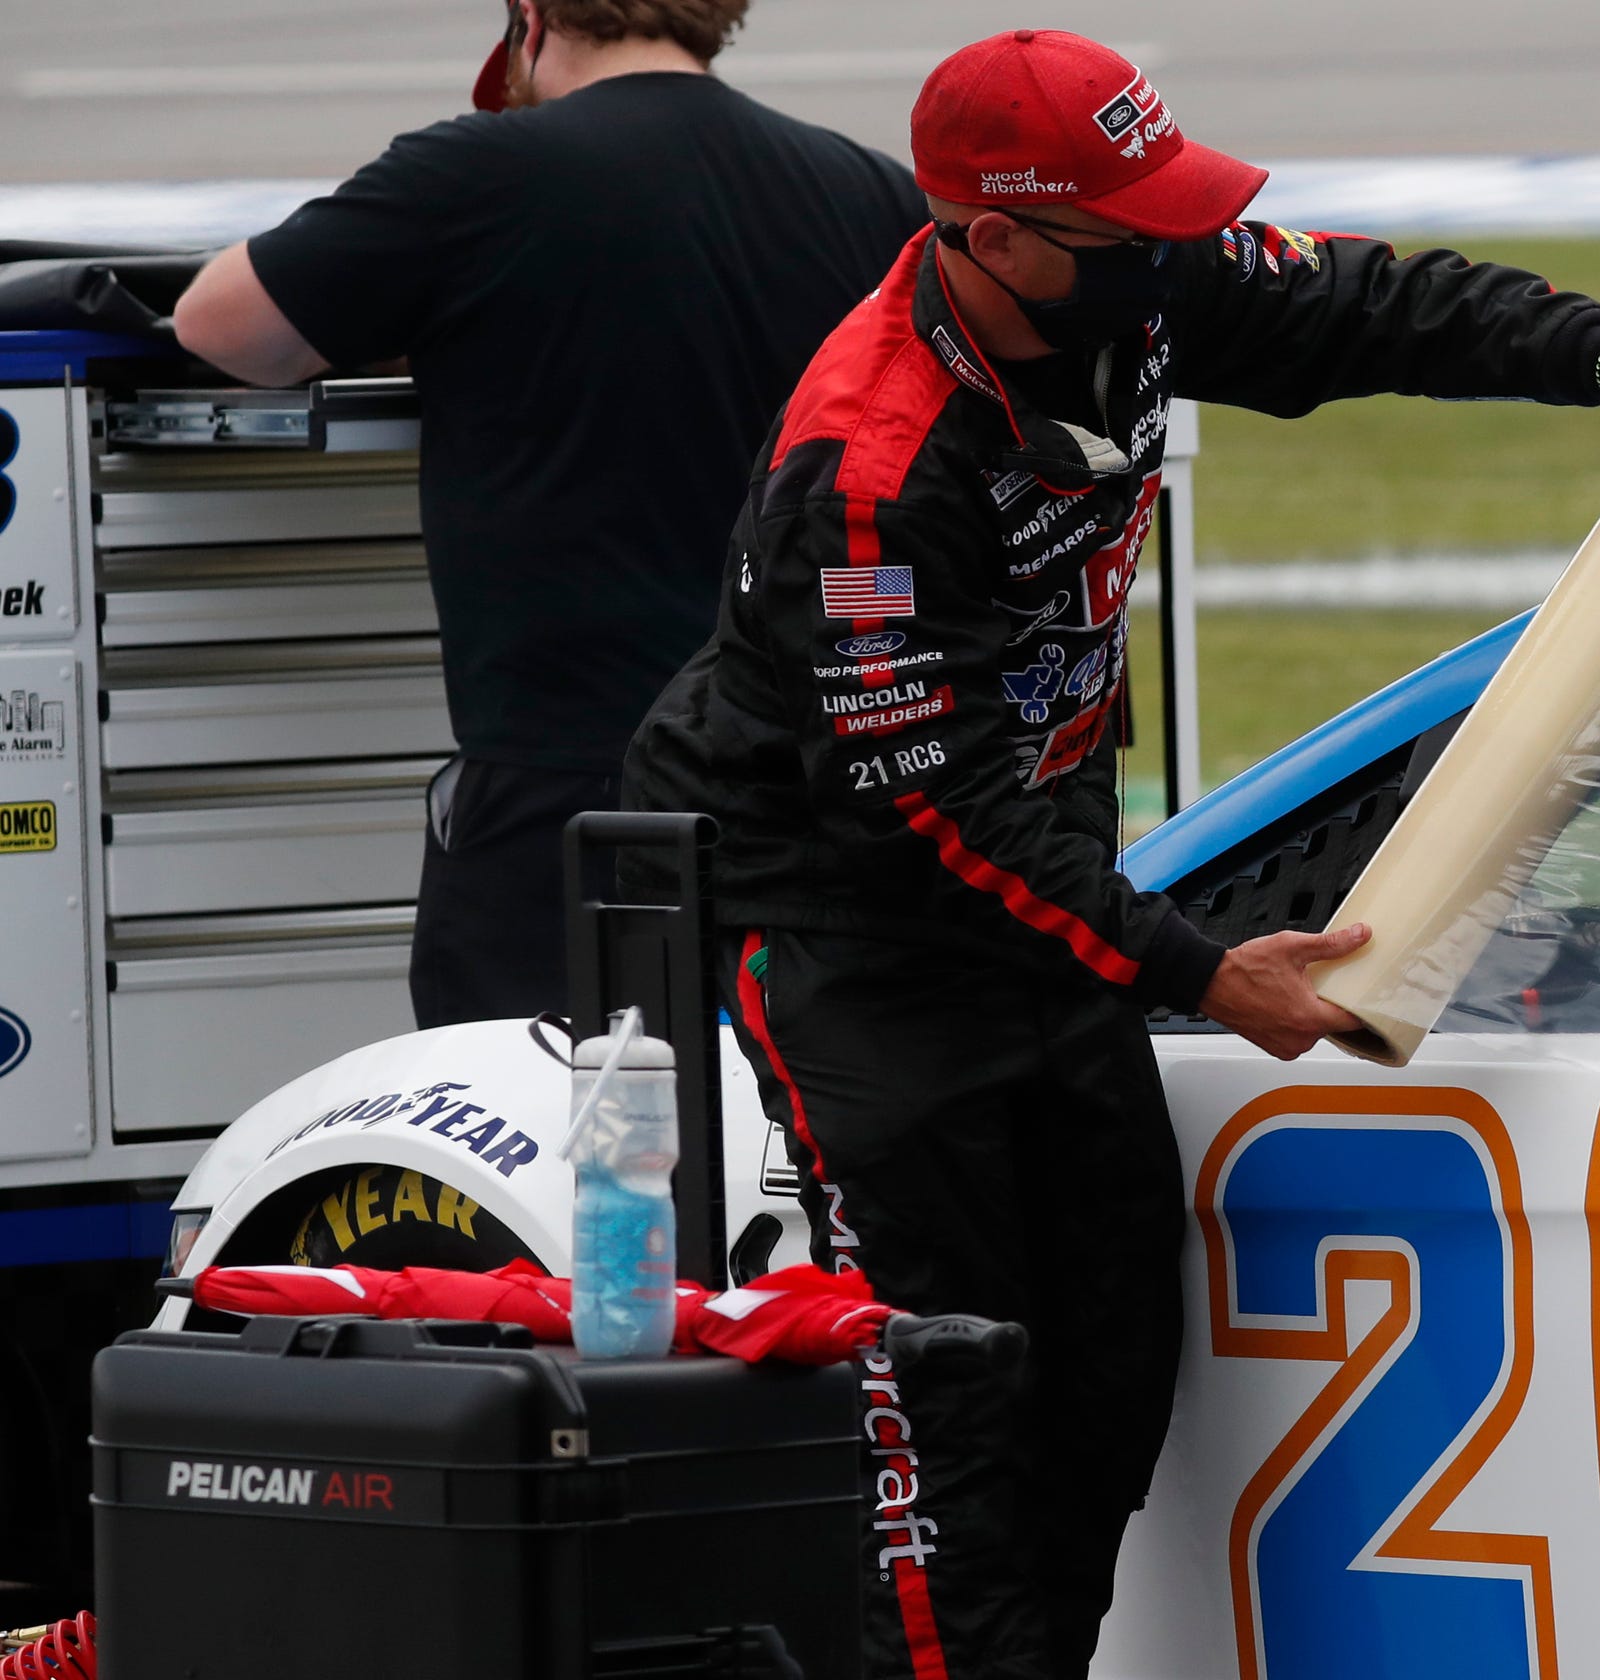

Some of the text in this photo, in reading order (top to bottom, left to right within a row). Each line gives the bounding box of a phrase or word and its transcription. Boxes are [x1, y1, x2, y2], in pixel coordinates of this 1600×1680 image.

[981, 167, 1035, 181] wood
[1147, 338, 1170, 380] #2
[1009, 519, 1097, 576] MENARDS
[0, 580, 45, 616] ek
[850, 636, 893, 654] Ford
[842, 651, 943, 676] PERFORMANCE
[823, 681, 926, 714] LINCOLN
[846, 698, 943, 732] WELDERS
[11, 738, 52, 751] Alarm
[849, 741, 946, 790] 21 RC6
[322, 1166, 480, 1252] YEAR
[821, 1184, 939, 1570] Moorcraft
[167, 1461, 395, 1511] PELICAN AIR
